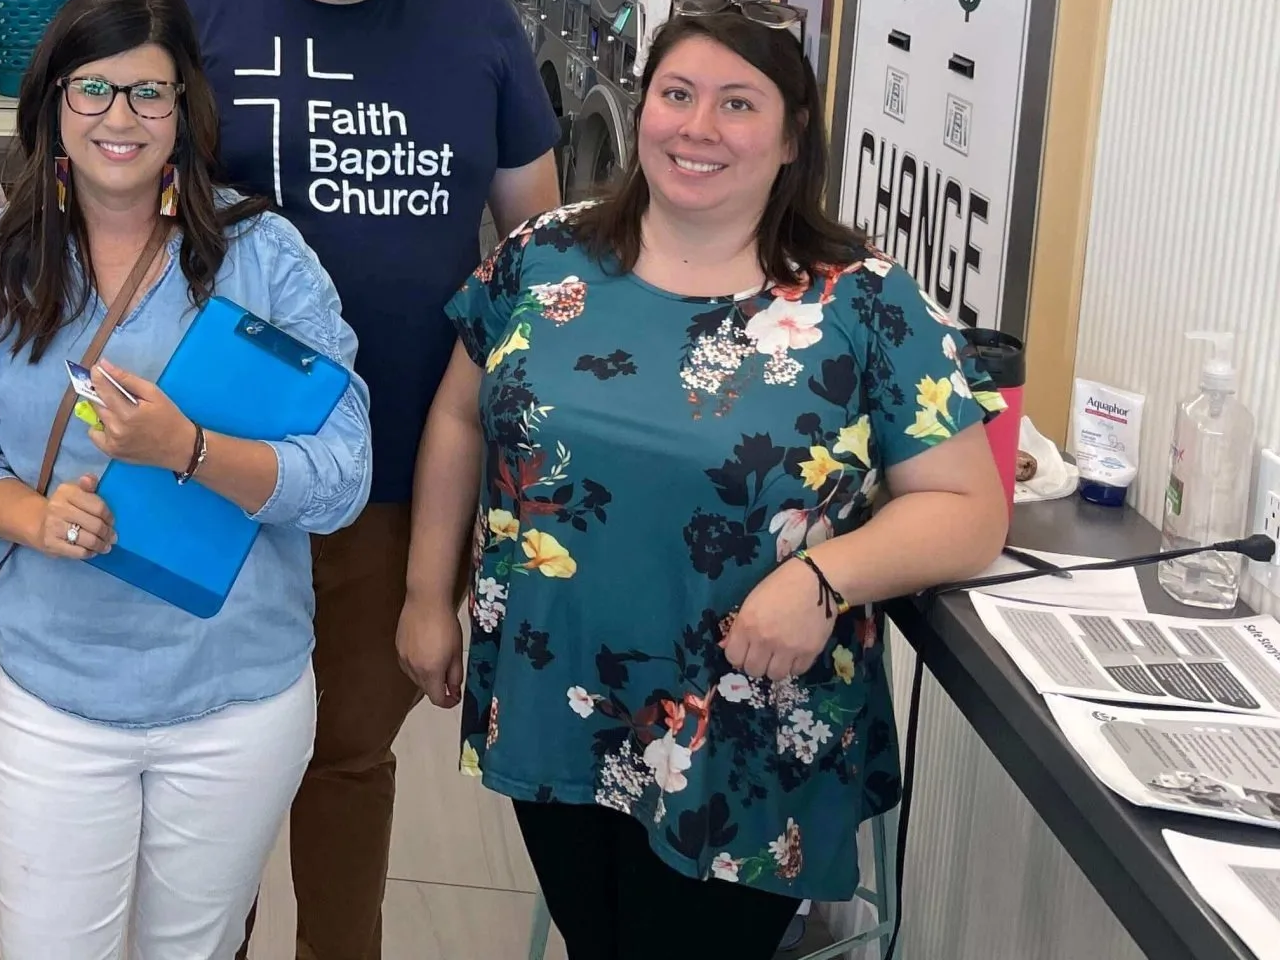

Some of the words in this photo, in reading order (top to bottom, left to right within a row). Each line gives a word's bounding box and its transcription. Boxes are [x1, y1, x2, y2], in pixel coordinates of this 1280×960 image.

[307, 100, 407, 136] Faith
[309, 139, 454, 180] Baptist
[308, 177, 449, 216] Church
[854, 128, 991, 328] CHANGE
[1086, 396, 1128, 417] Aquaphor
